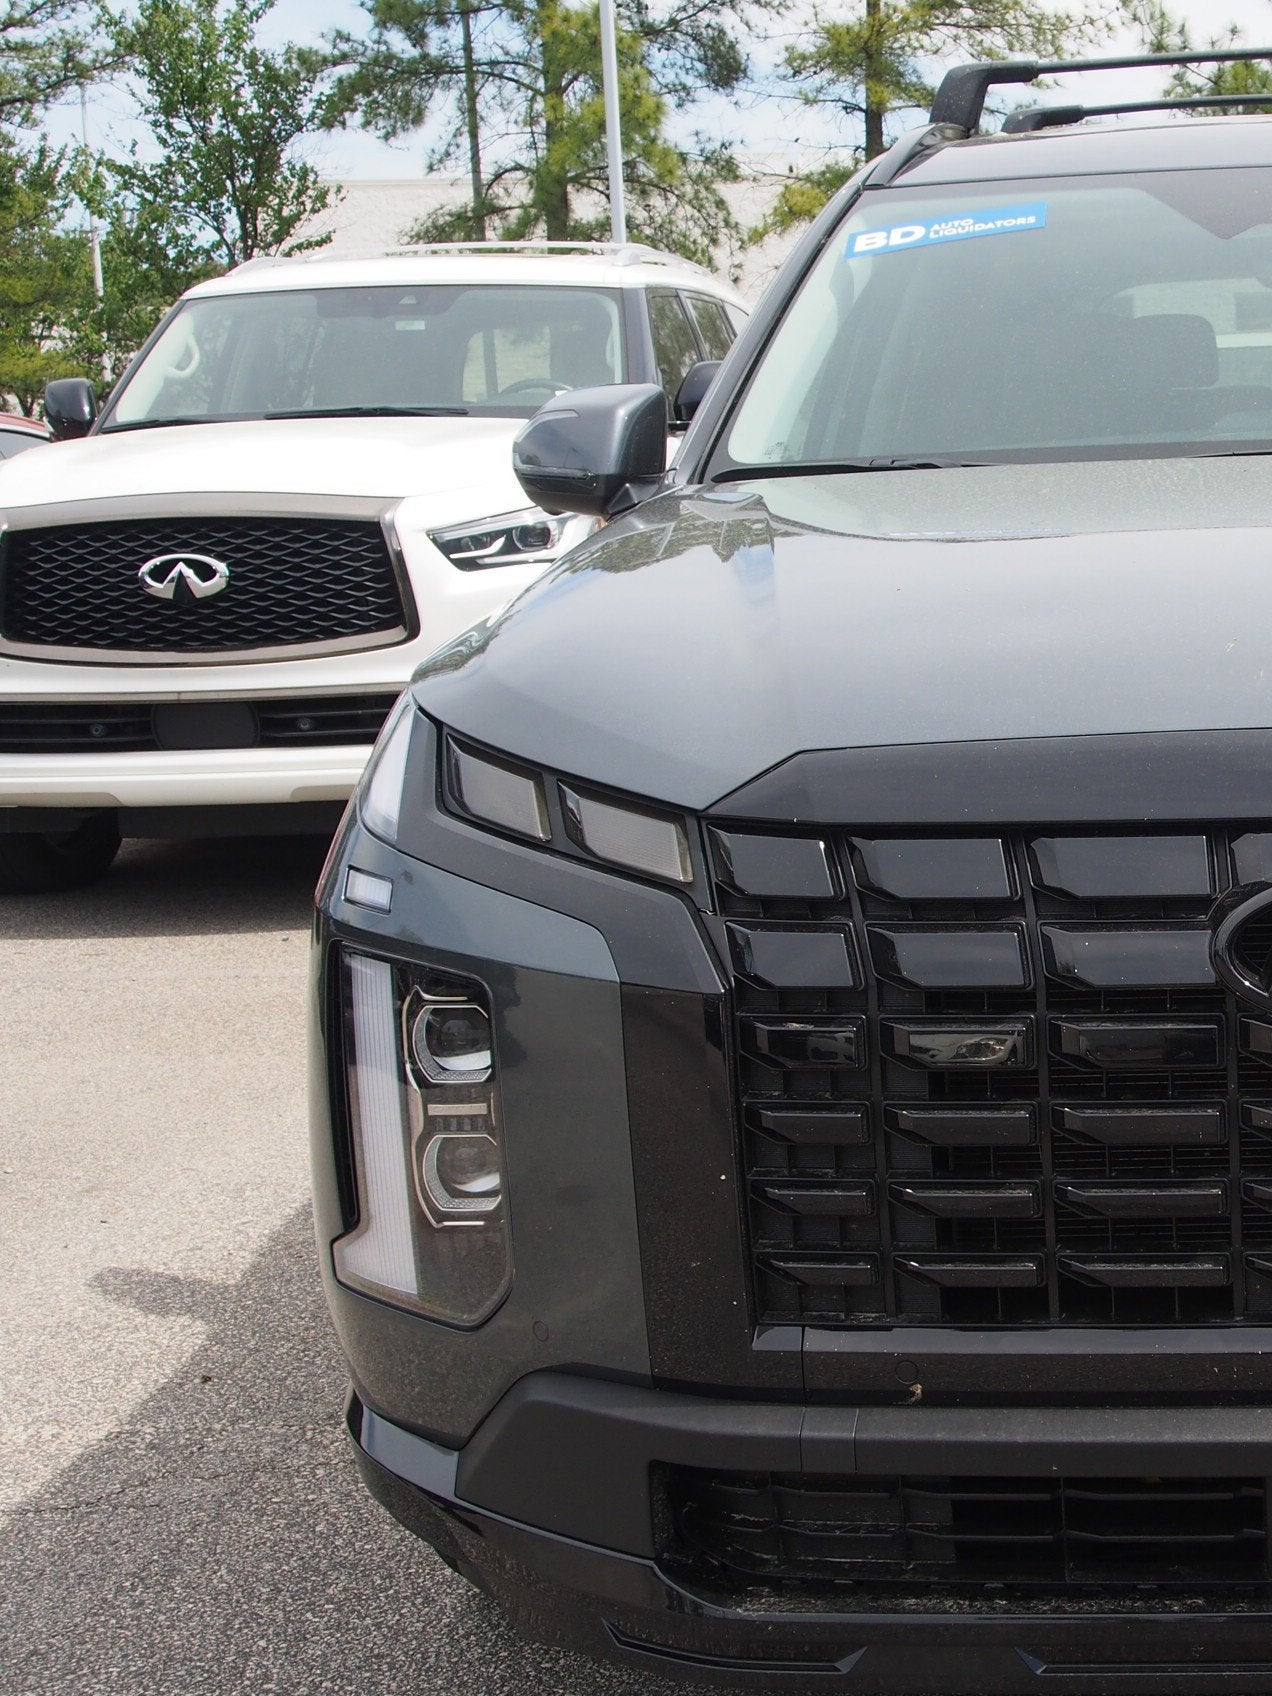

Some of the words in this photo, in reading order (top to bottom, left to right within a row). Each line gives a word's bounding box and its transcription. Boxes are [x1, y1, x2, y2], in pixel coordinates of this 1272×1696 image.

[929, 217, 1036, 238] LIQUIDATORS
[931, 218, 974, 231] AUTO
[854, 225, 926, 253] BD
